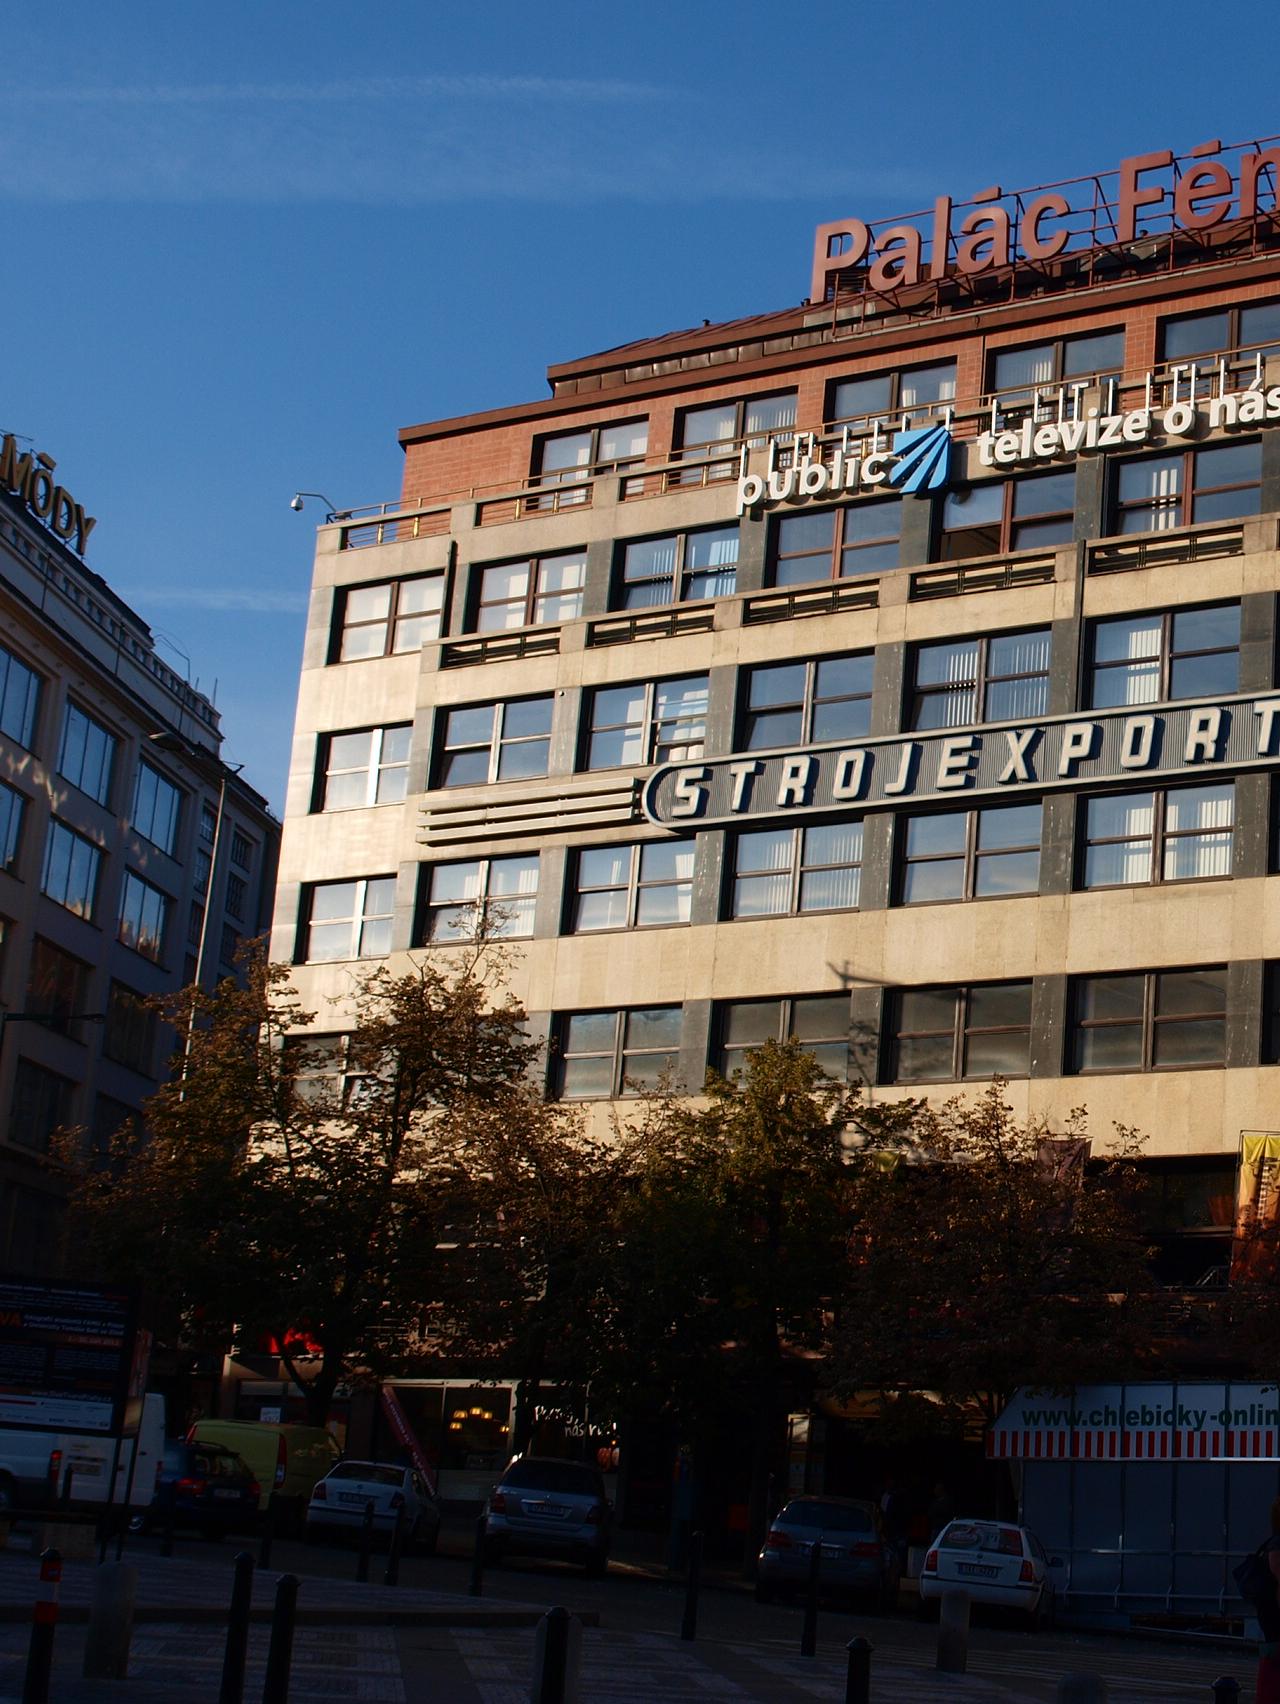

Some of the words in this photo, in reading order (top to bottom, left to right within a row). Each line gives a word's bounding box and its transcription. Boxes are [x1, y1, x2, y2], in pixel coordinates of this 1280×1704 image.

[811, 185, 1070, 304] Palác
[977, 405, 1151, 470] televize
[1163, 398, 1194, 436] o
[735, 440, 890, 516] public
